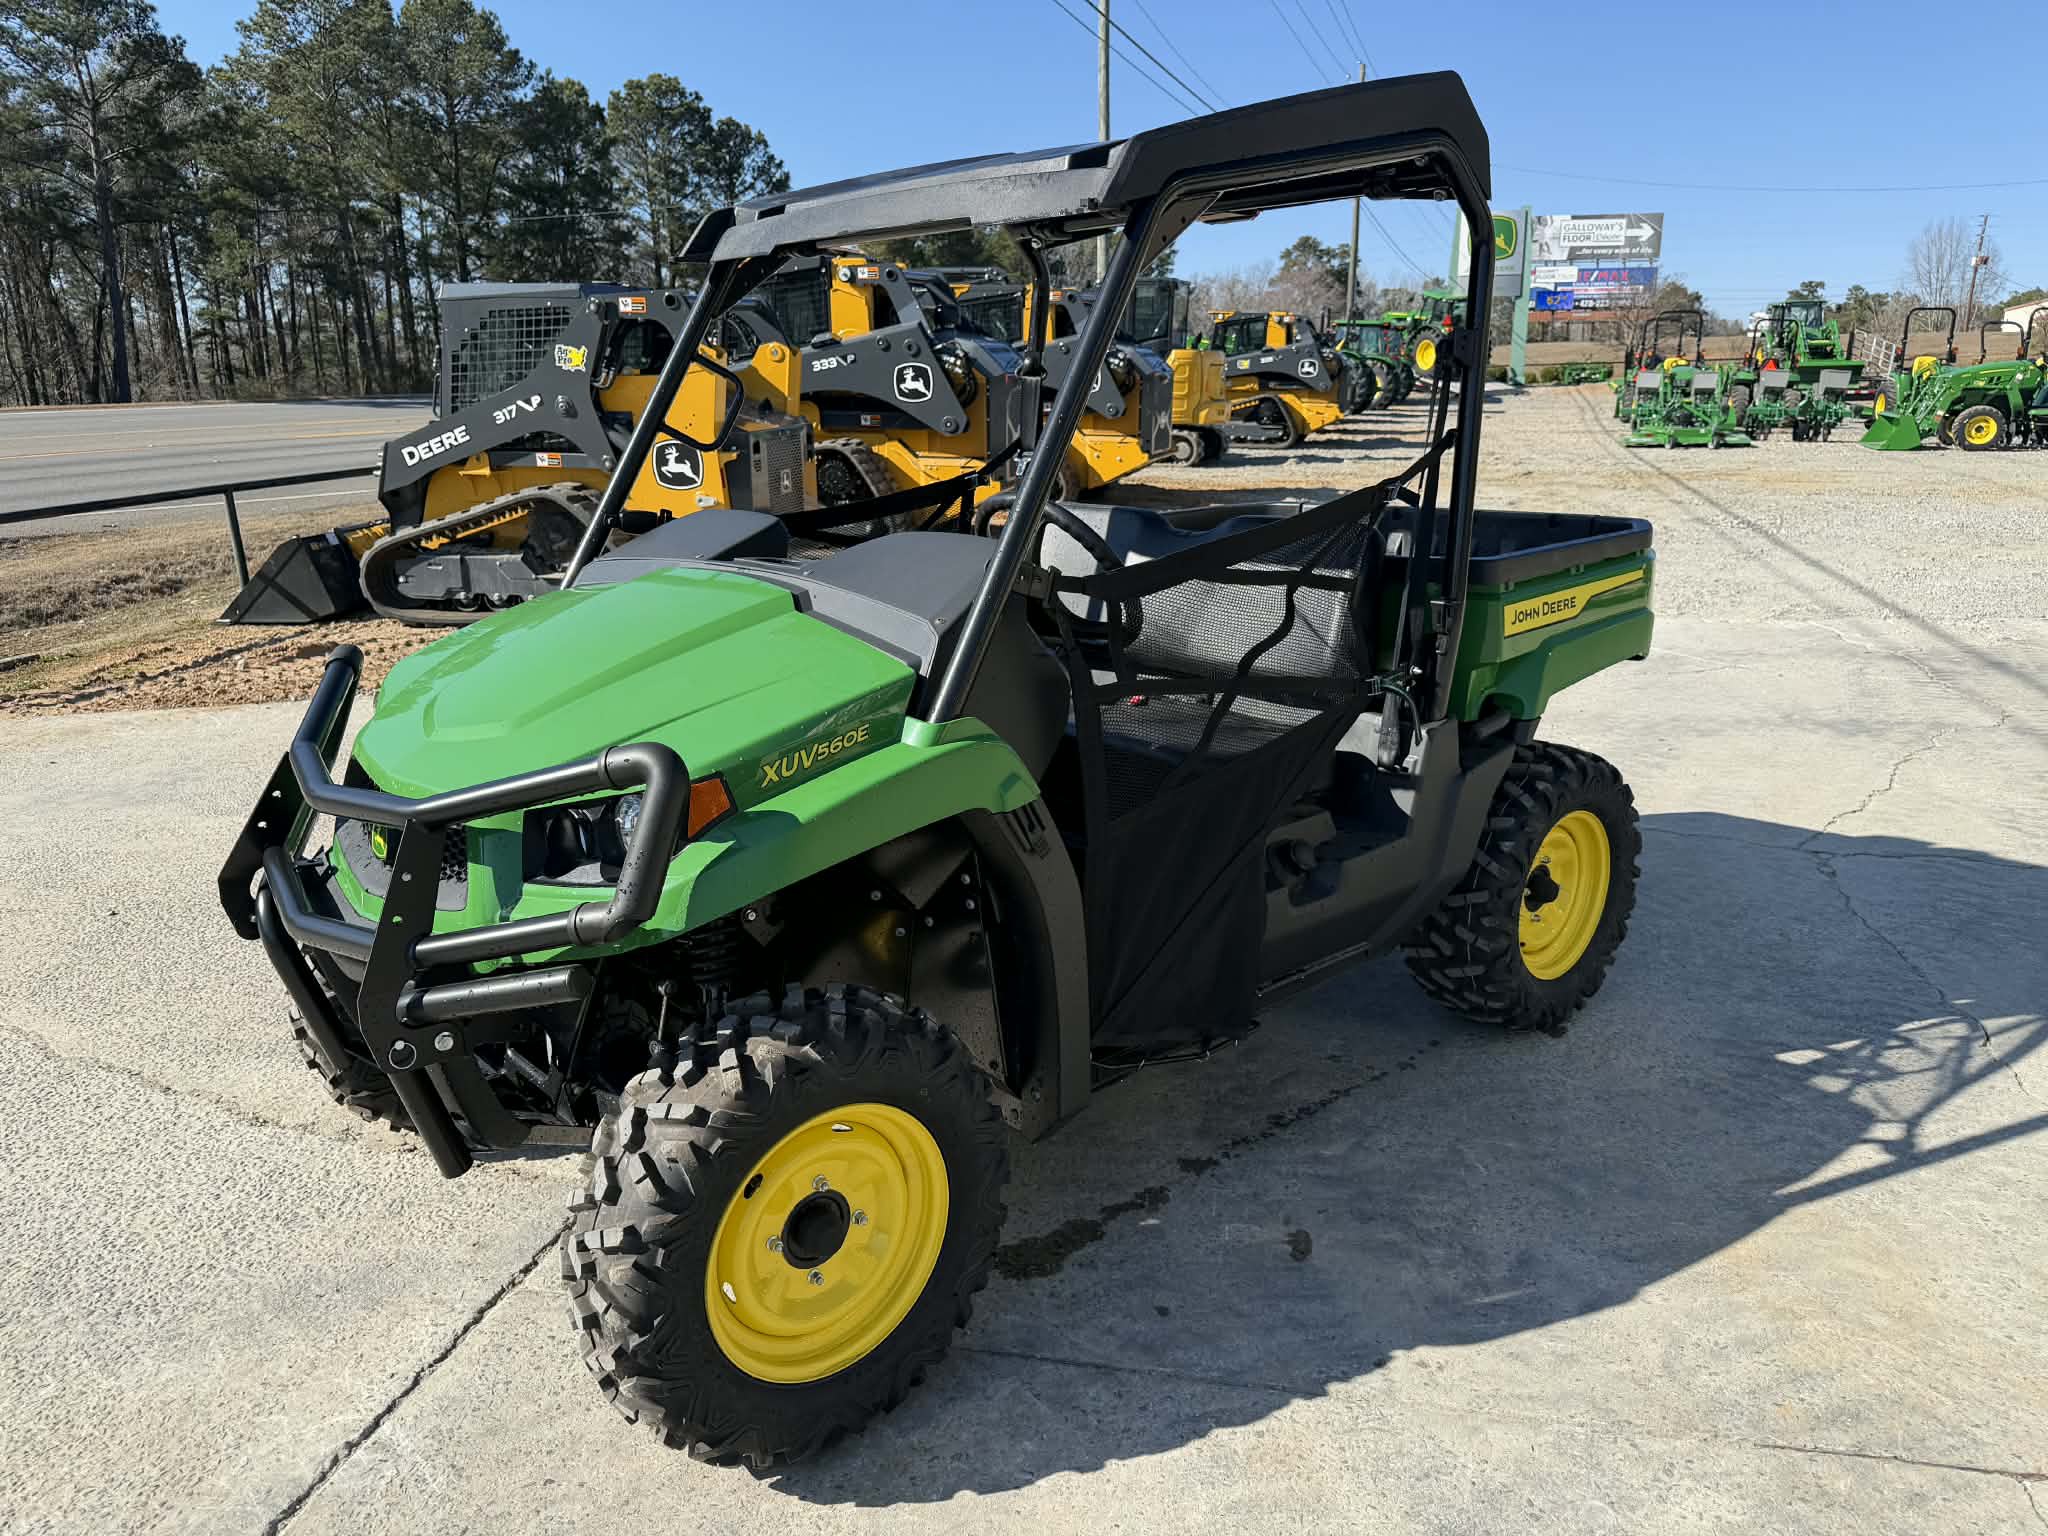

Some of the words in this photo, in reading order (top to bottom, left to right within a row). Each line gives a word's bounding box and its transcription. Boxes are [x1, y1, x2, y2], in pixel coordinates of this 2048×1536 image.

[1563, 221, 1624, 232] GALLOWAY'S
[1563, 234, 1592, 242] FLOOR
[401, 424, 471, 467] DEERE
[1511, 604, 1540, 625] JOHN
[1542, 596, 1577, 616] DEERE
[760, 723, 870, 788] XUV560E
